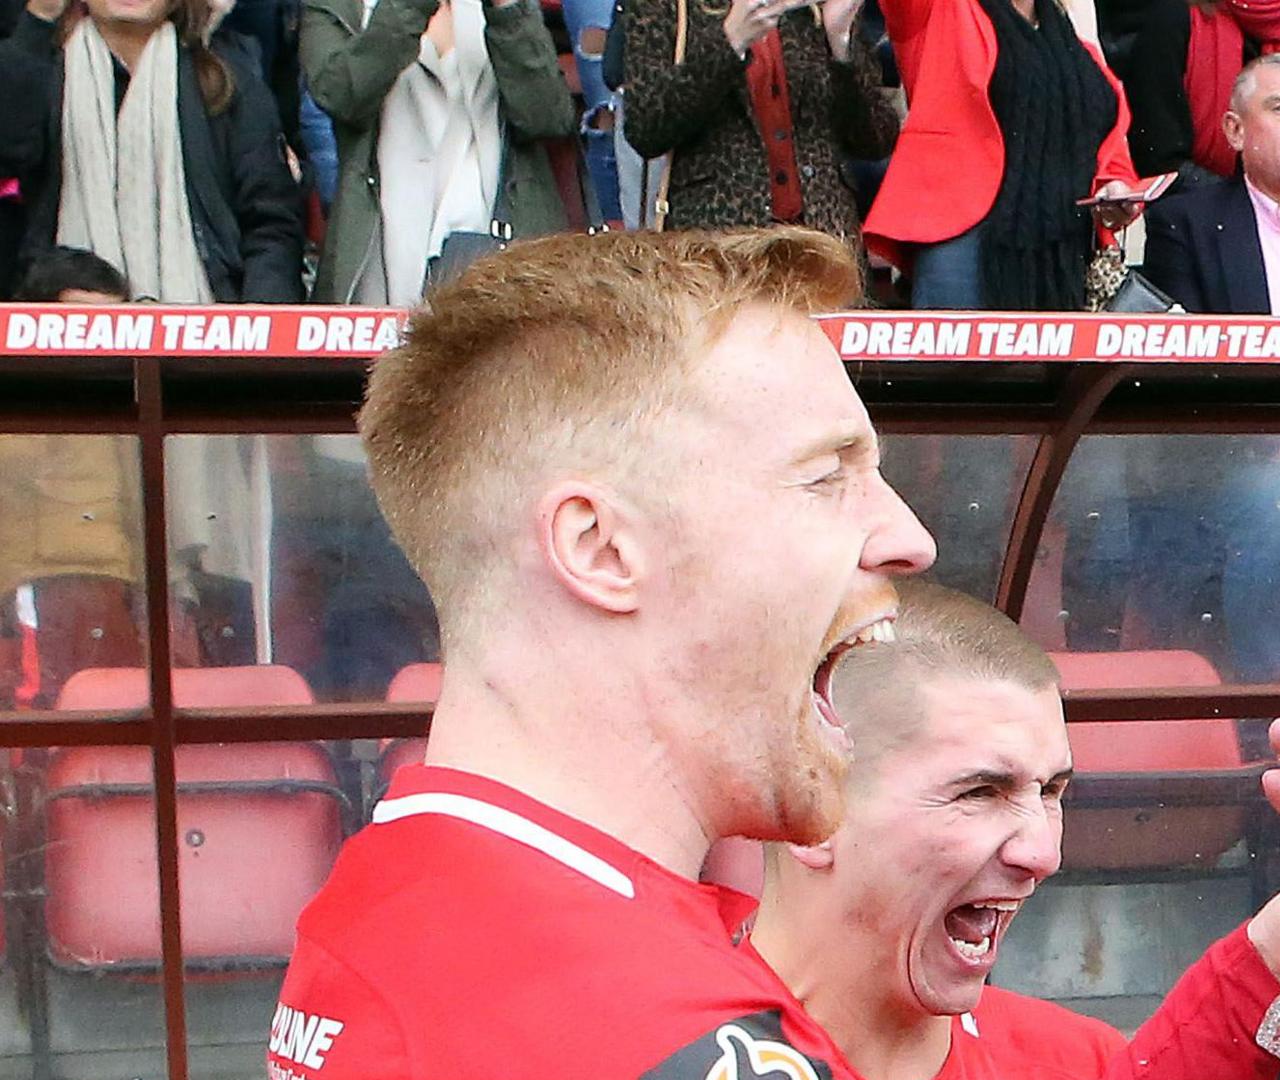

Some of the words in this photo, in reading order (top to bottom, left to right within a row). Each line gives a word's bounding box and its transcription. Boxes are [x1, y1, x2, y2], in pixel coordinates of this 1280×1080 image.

[5, 313, 154, 350] DREAM
[161, 314, 272, 351] TEAM
[295, 316, 402, 352] DREA
[840, 322, 971, 355] DREAM
[977, 323, 1074, 356] TEAM
[1095, 324, 1220, 358] DREAM
